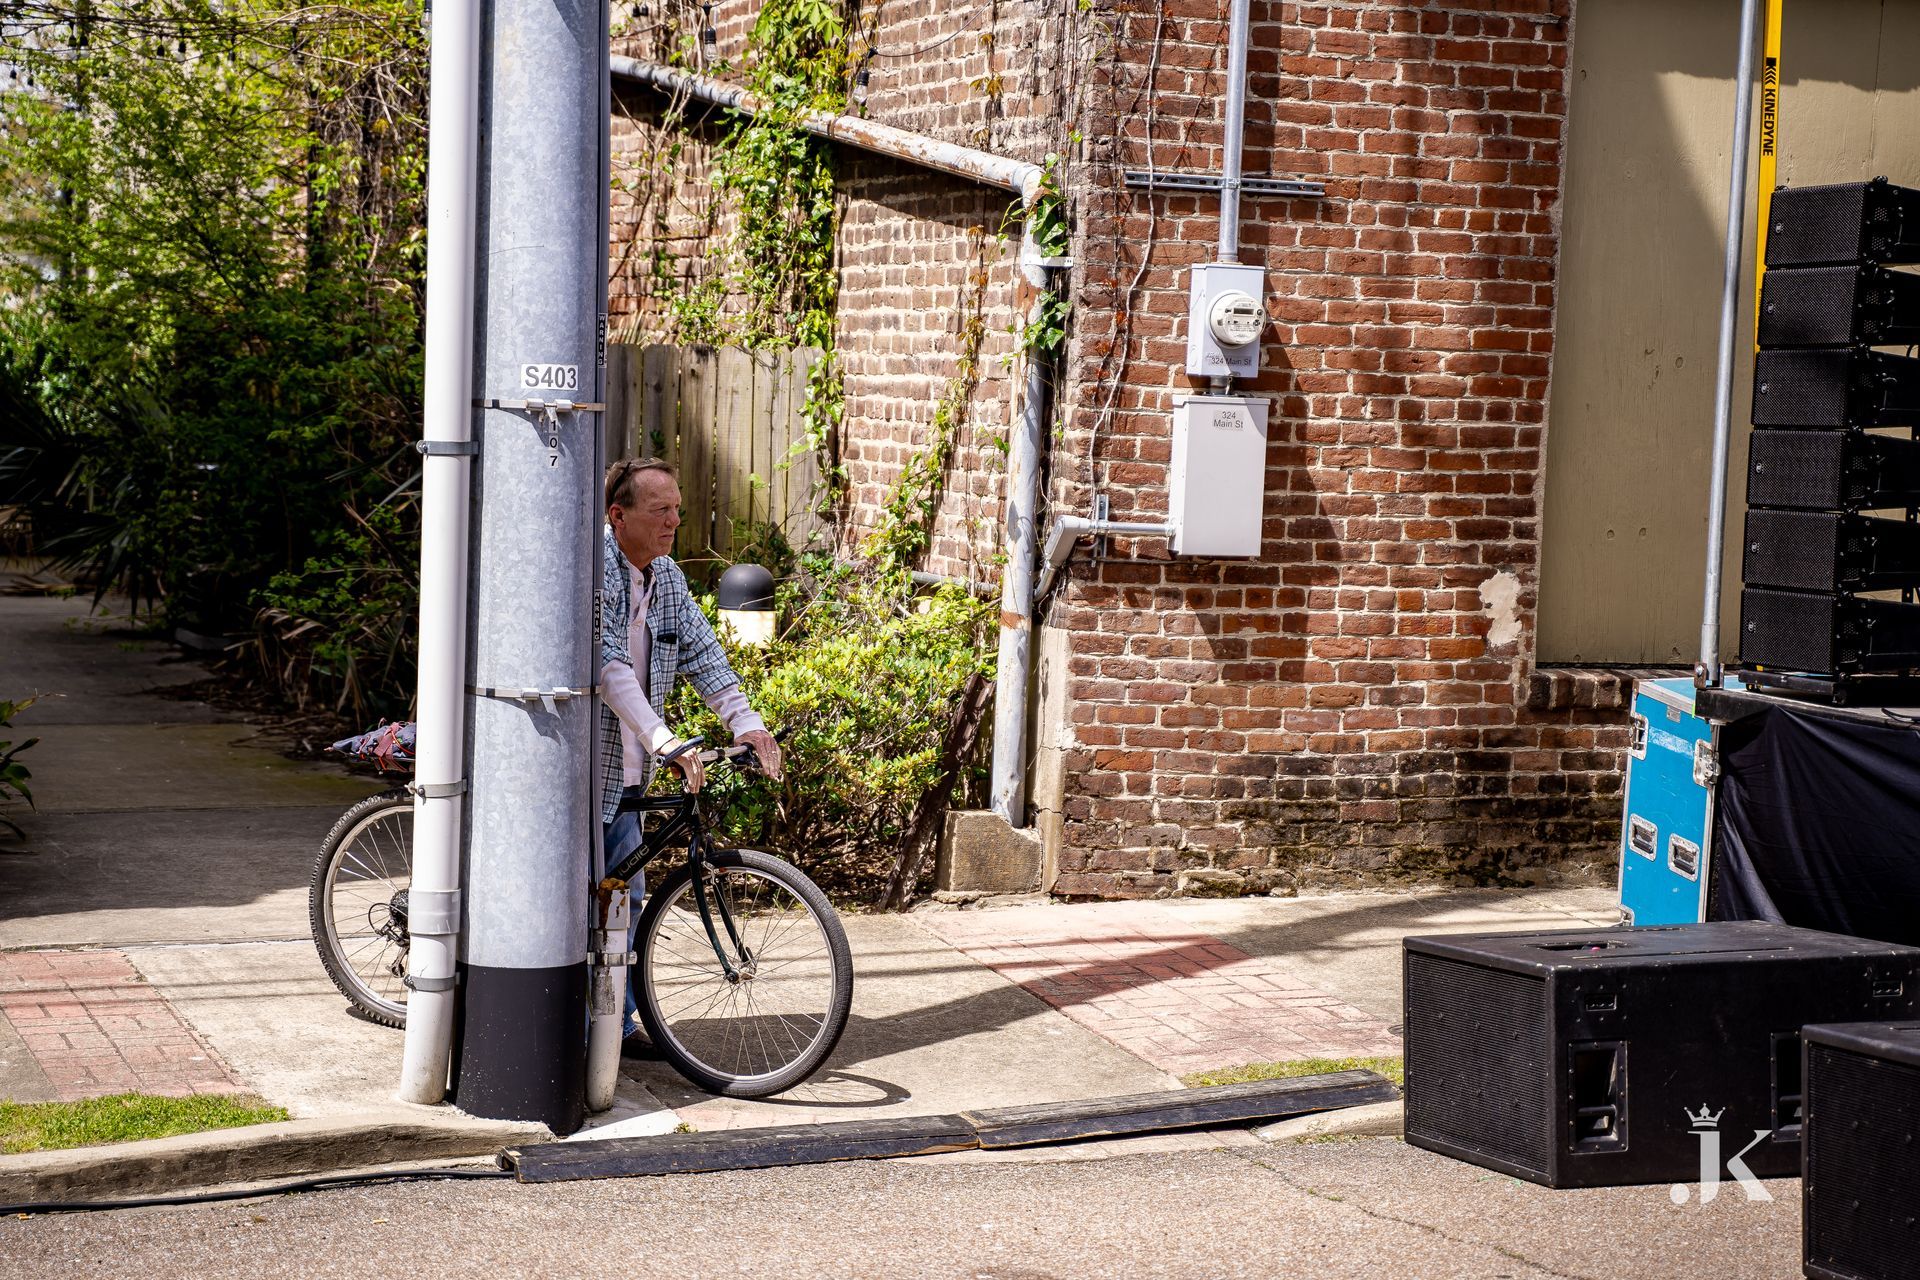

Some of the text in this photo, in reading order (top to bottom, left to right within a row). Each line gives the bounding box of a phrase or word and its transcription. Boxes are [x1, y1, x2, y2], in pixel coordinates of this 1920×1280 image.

[1763, 88, 1776, 157] KINEDYNE
[598, 315, 606, 366] WARNING
[1211, 357, 1252, 366] 324 Main St
[525, 365, 577, 389] S403
[1213, 411, 1244, 428] 324 Main St
